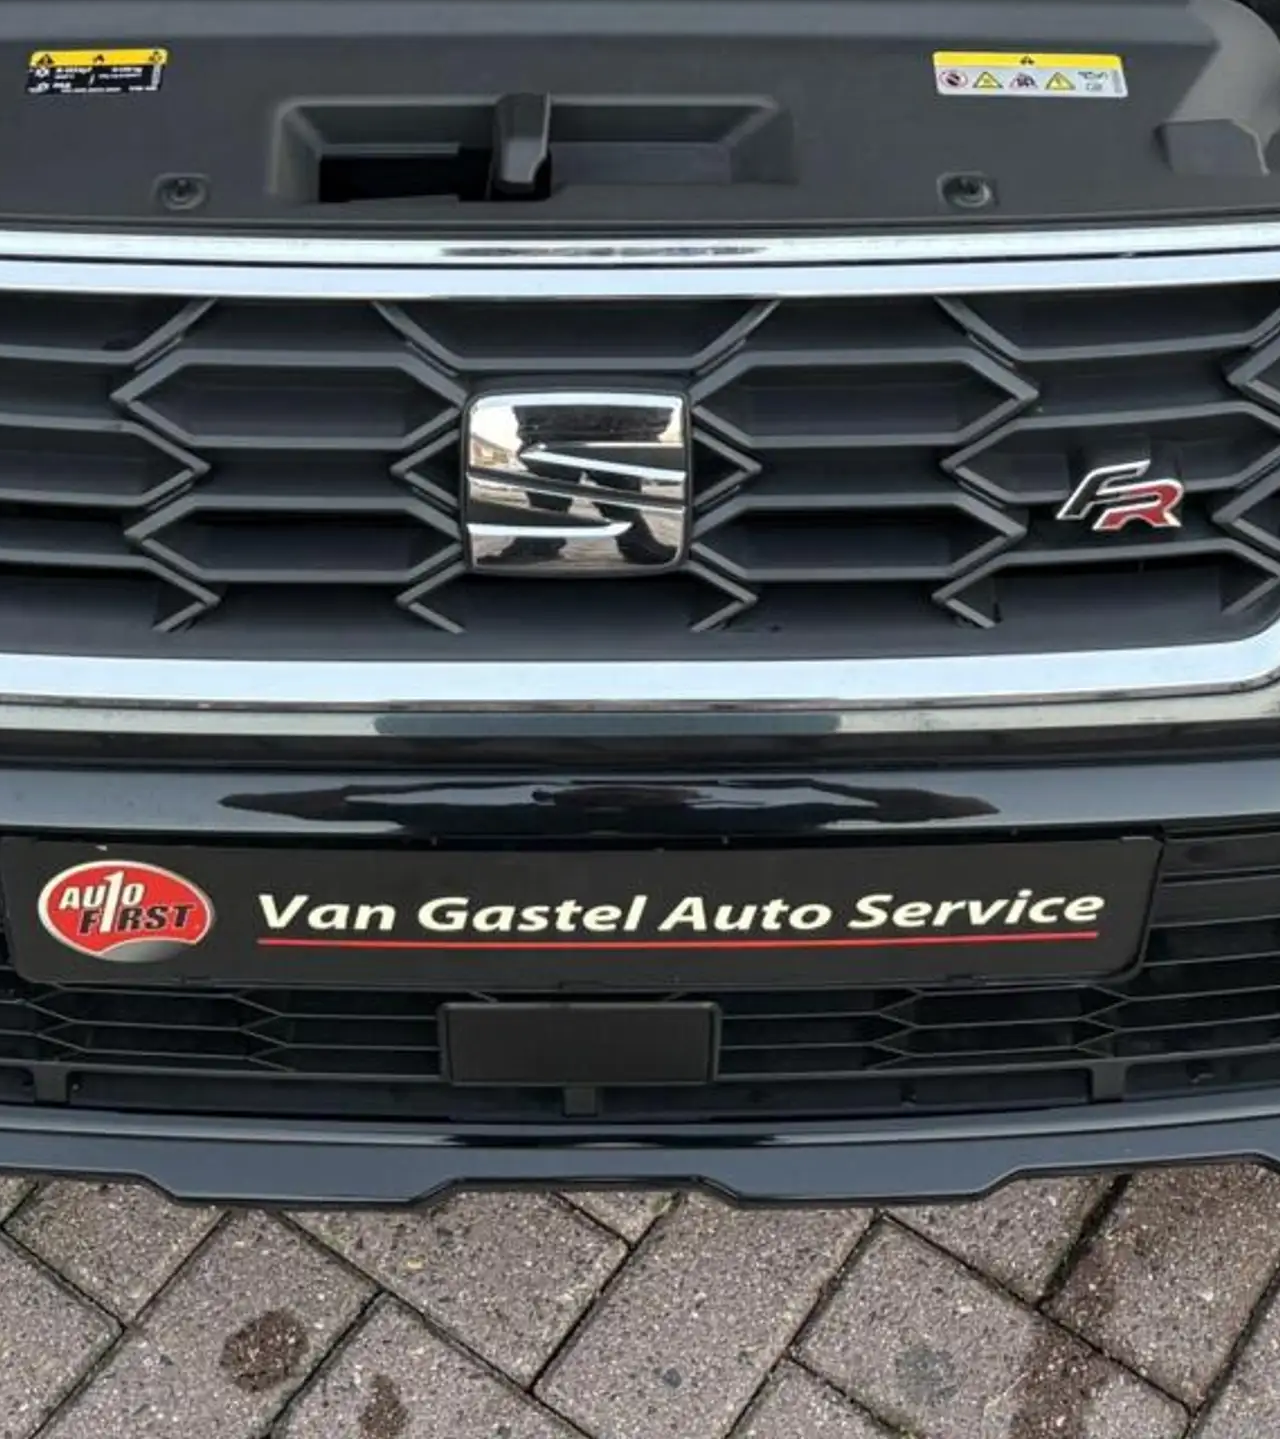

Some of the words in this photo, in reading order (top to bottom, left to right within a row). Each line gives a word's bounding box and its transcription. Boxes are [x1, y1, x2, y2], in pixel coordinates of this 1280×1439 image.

[1056, 459, 1184, 531] FR
[257, 893, 396, 931] Van
[417, 893, 649, 933] Gastel
[657, 894, 833, 932] Auto
[847, 888, 1105, 930] Service
